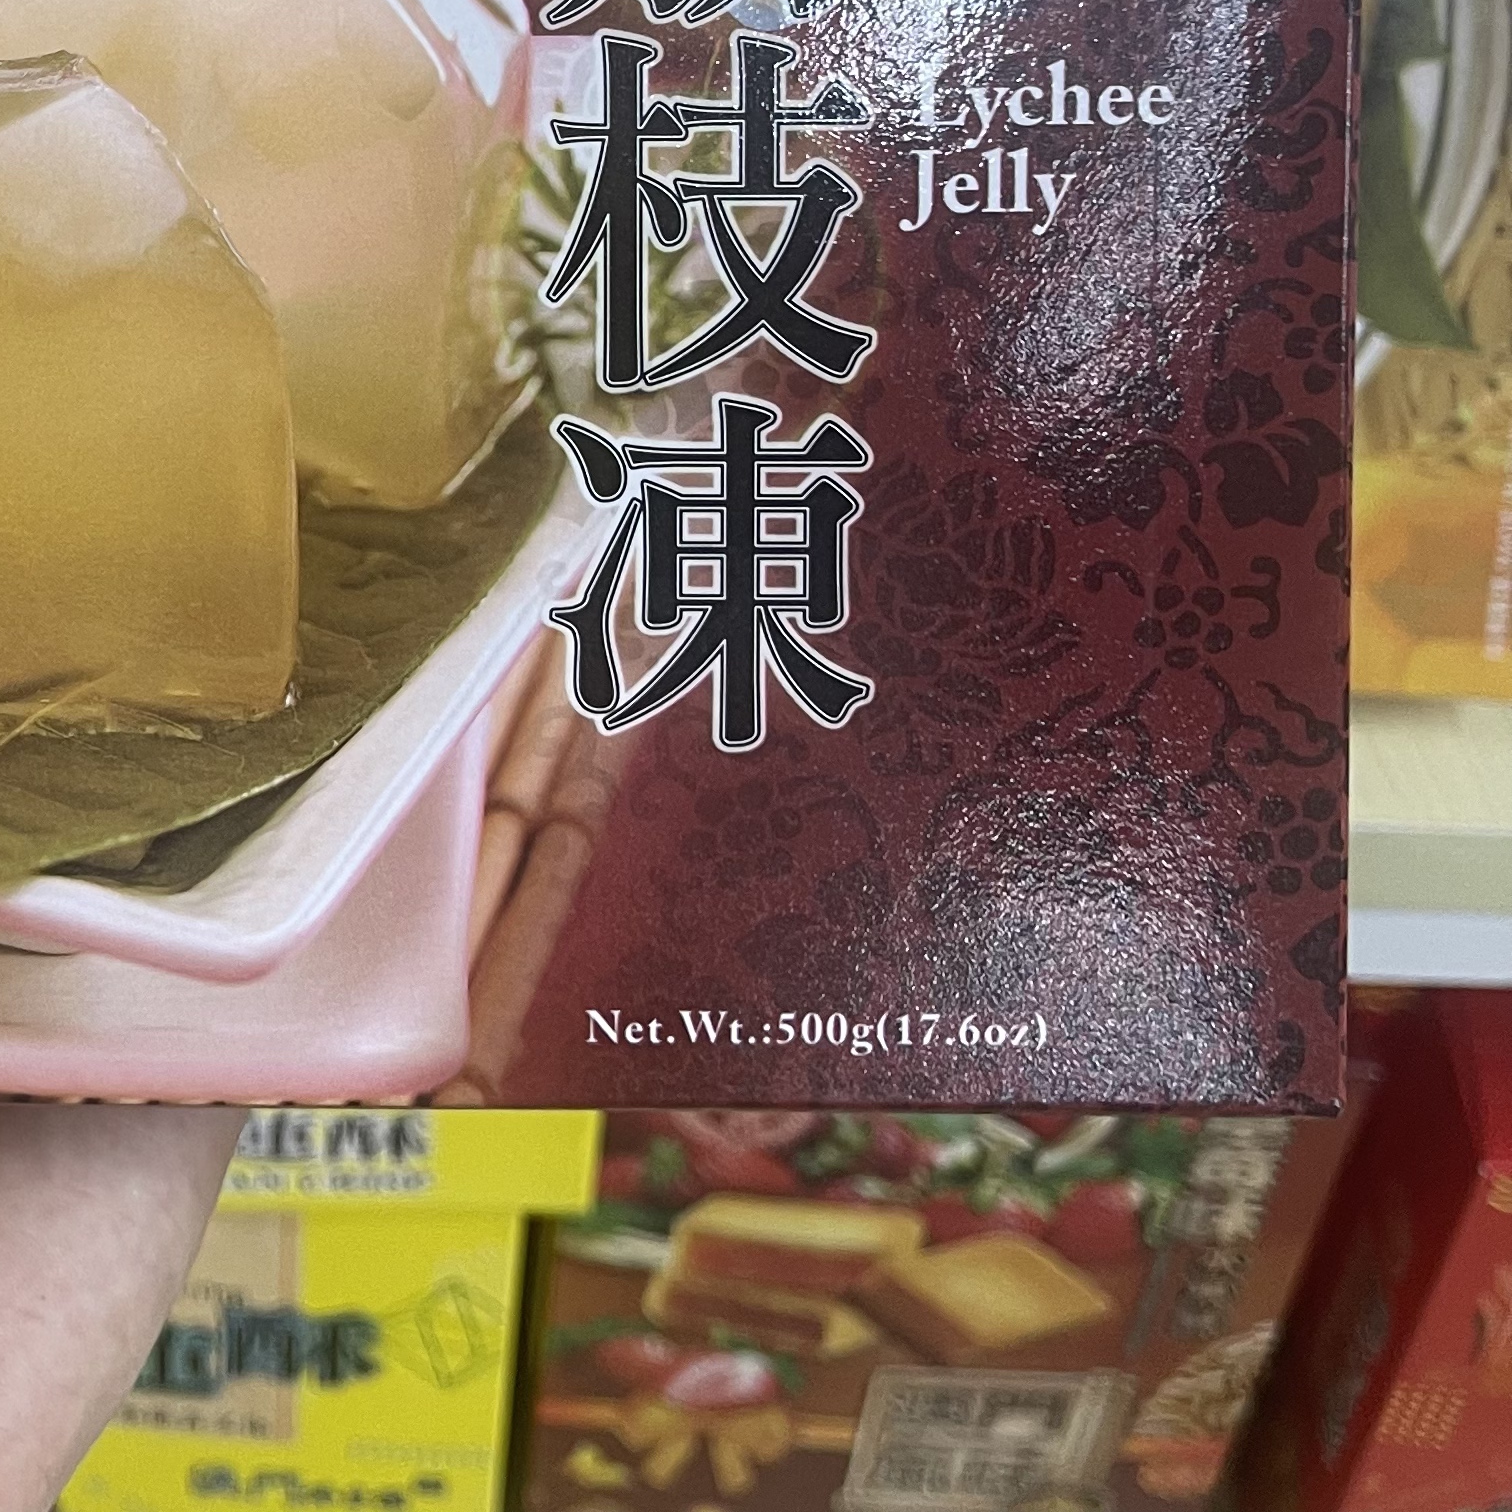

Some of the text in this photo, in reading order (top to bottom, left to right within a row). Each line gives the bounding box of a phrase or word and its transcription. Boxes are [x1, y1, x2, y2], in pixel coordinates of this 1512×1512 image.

[915, 59, 1174, 149] Lychee
[898, 147, 1076, 236] Jelly
[585, 1008, 1048, 1055] Net.Wt.:500g(17.6oz)
